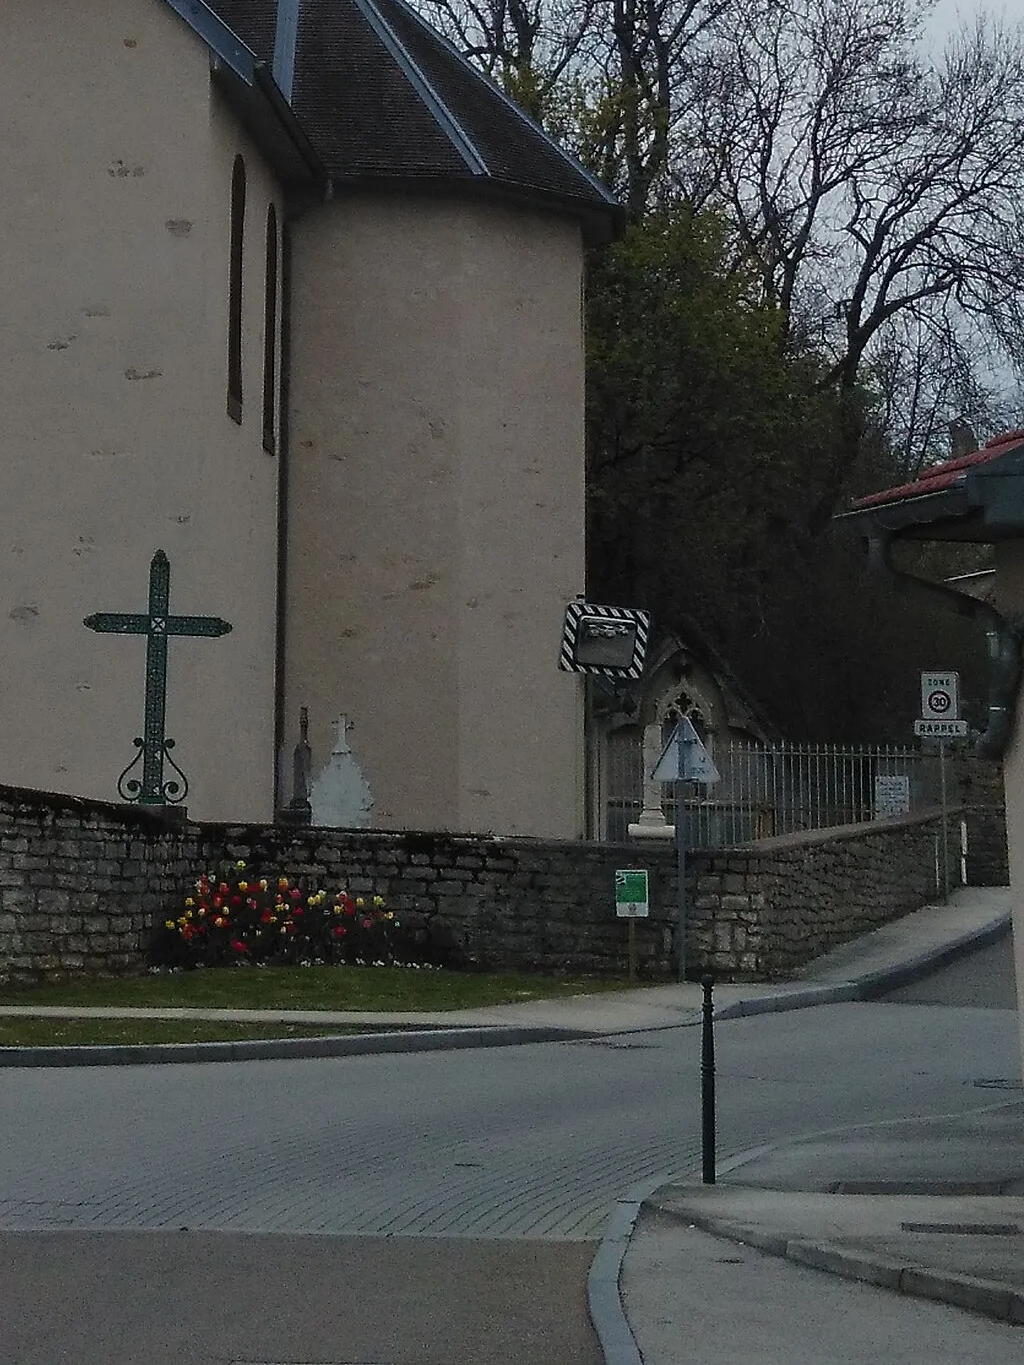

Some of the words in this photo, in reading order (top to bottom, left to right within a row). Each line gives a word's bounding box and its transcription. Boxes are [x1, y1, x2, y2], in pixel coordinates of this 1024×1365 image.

[927, 678, 950, 686] ZONE
[932, 697, 947, 707] 30
[919, 724, 961, 733] RAPPEL
